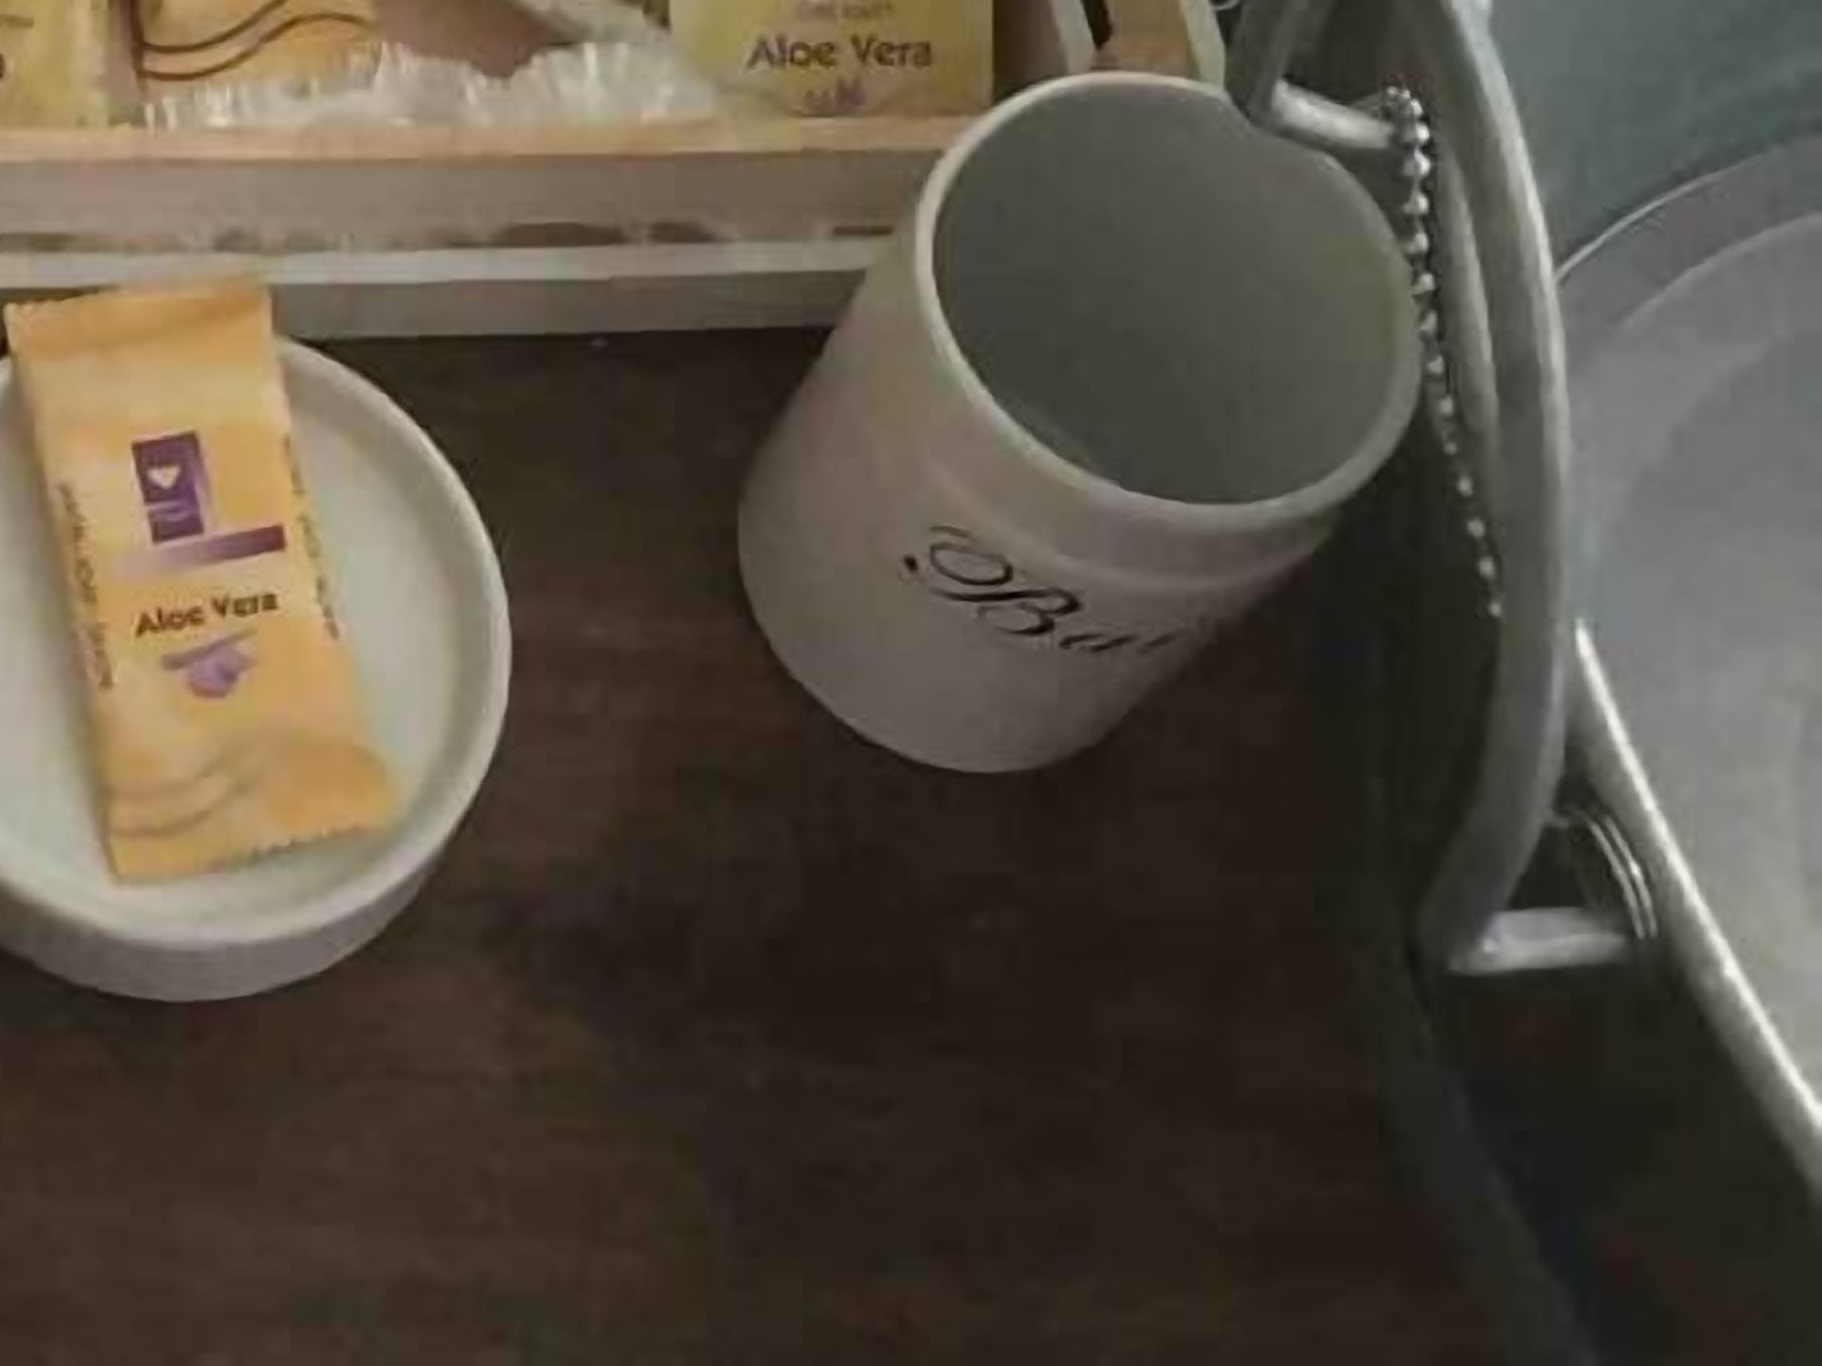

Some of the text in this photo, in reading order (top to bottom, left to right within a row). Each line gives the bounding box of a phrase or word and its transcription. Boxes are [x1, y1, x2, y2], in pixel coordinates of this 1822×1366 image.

[744, 32, 934, 71] Aloe Vera
[134, 592, 280, 638] Aloe Vera
